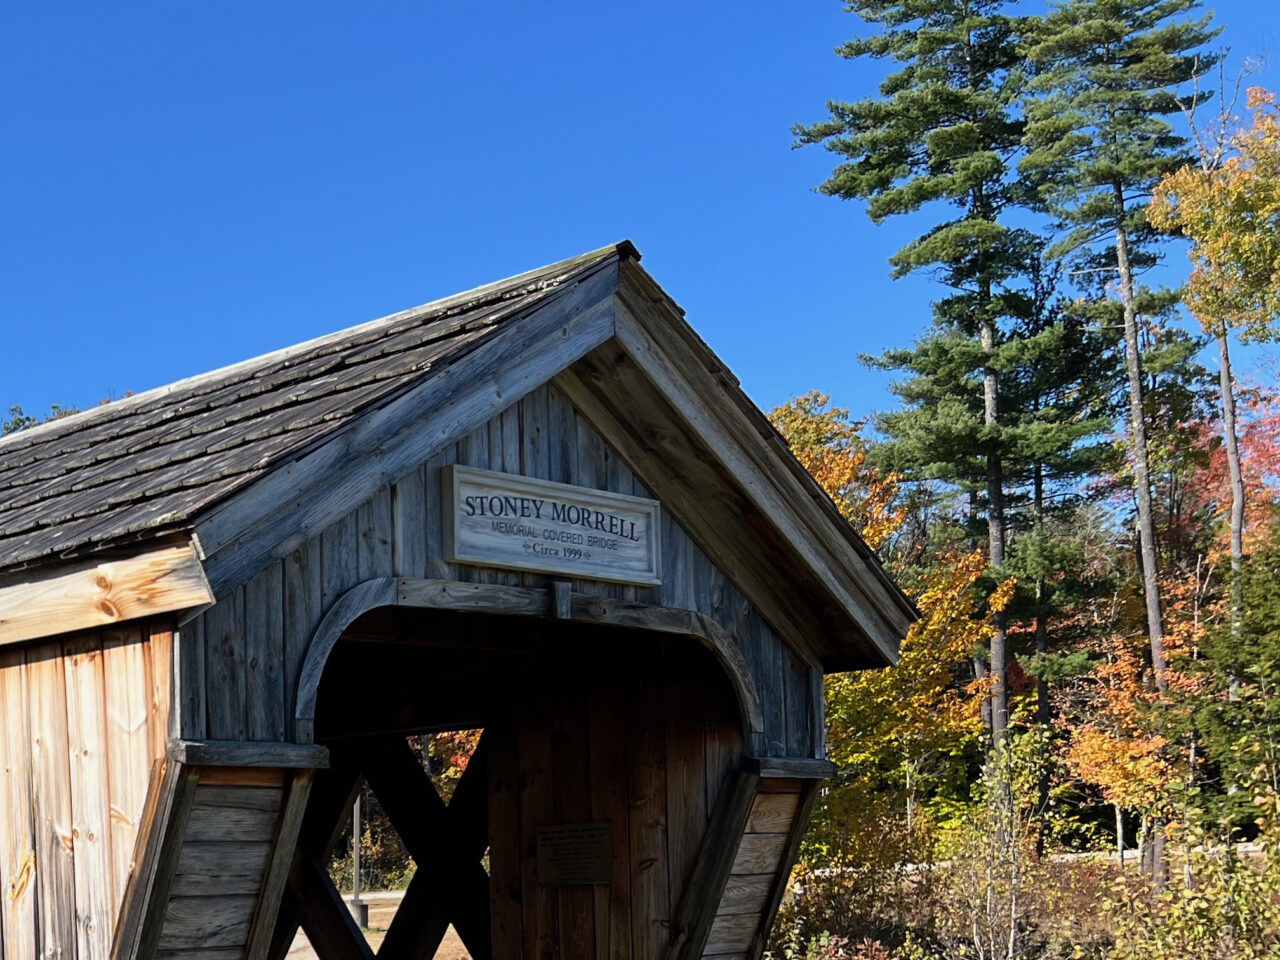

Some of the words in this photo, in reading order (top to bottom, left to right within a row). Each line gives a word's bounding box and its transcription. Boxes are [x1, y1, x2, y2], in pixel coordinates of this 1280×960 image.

[465, 495, 544, 519] STONEY
[551, 502, 640, 542] MORRELL
[491, 520, 538, 539] MEMORIAL
[543, 528, 583, 546] COVERED
[587, 535, 618, 551] BRIDGE
[532, 542, 559, 557] Circa
[563, 547, 582, 560] 1999
